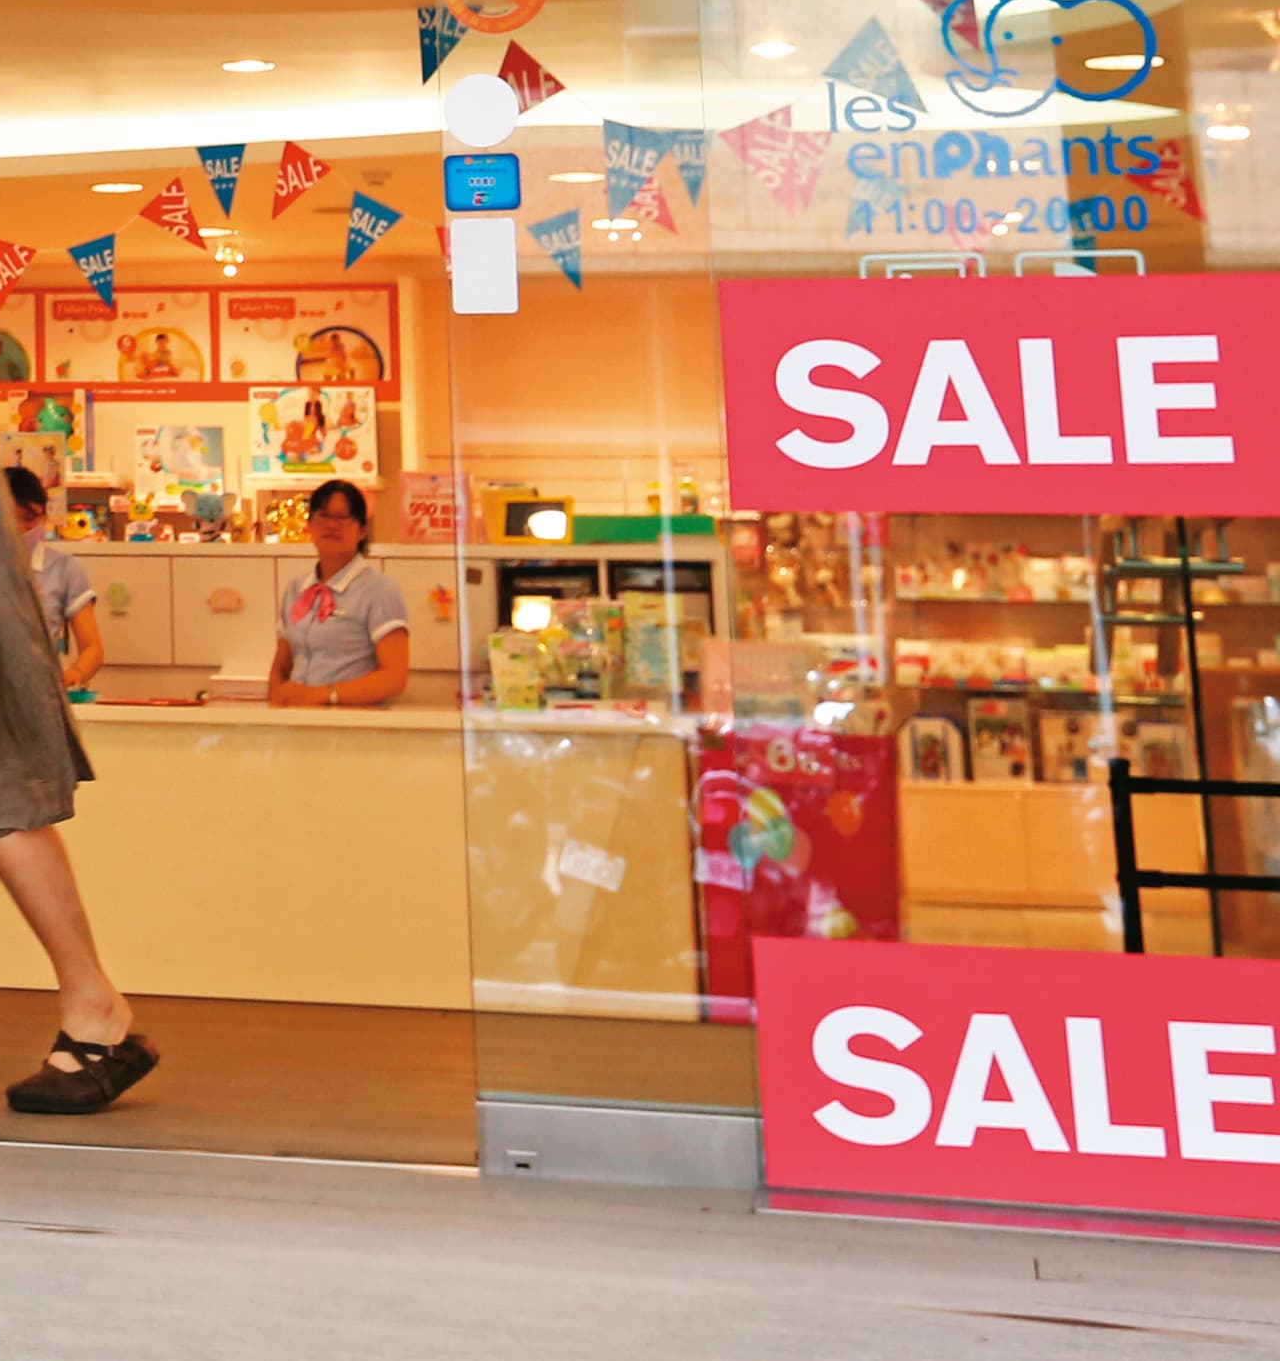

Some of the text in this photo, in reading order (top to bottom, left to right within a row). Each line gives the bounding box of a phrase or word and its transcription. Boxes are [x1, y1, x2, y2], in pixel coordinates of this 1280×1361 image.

[827, 80, 917, 133] les
[205, 156, 240, 179] SALE
[606, 139, 657, 177] SALE
[351, 207, 388, 240] SALE
[79, 249, 113, 278] SALE
[775, 334, 1235, 469] SALE
[811, 1005, 1280, 1164] SALE
